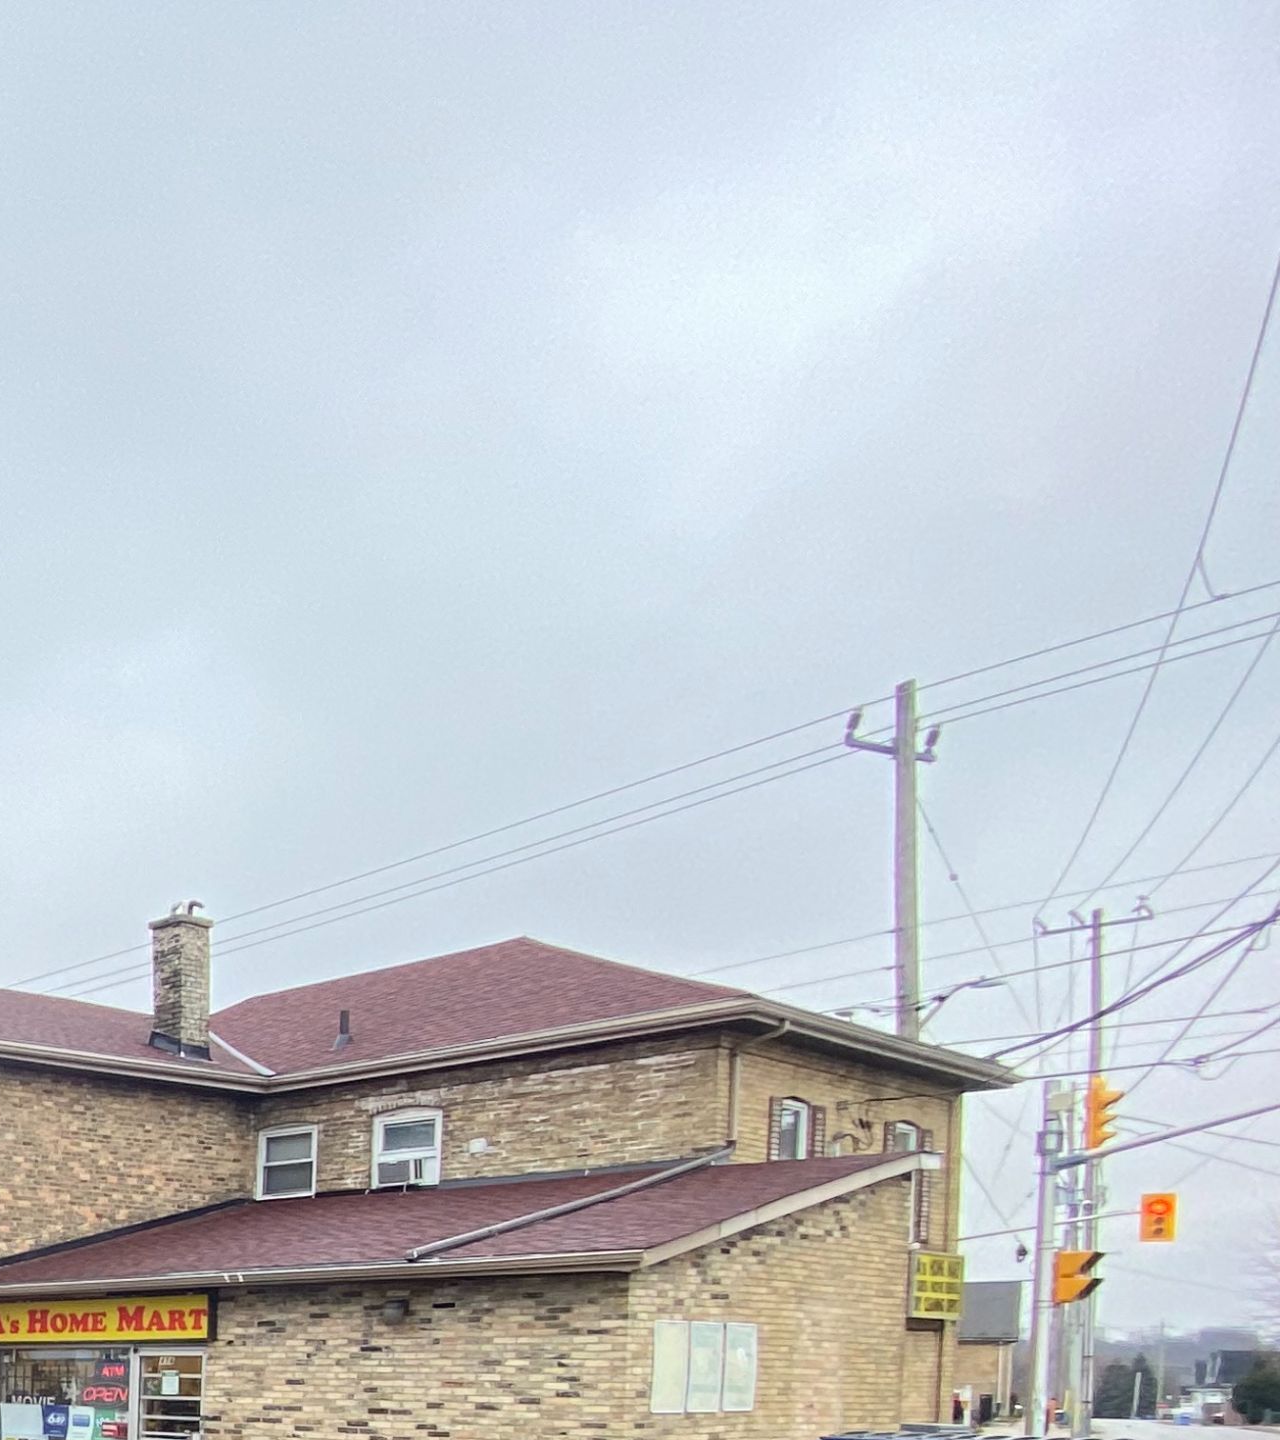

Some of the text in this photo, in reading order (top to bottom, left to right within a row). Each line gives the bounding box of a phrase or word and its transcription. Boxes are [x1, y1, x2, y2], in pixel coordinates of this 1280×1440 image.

[27, 1308, 107, 1334] HOME
[116, 1305, 208, 1332] MART
[101, 1364, 126, 1377] ATM
[83, 1386, 128, 1403] OPEN
